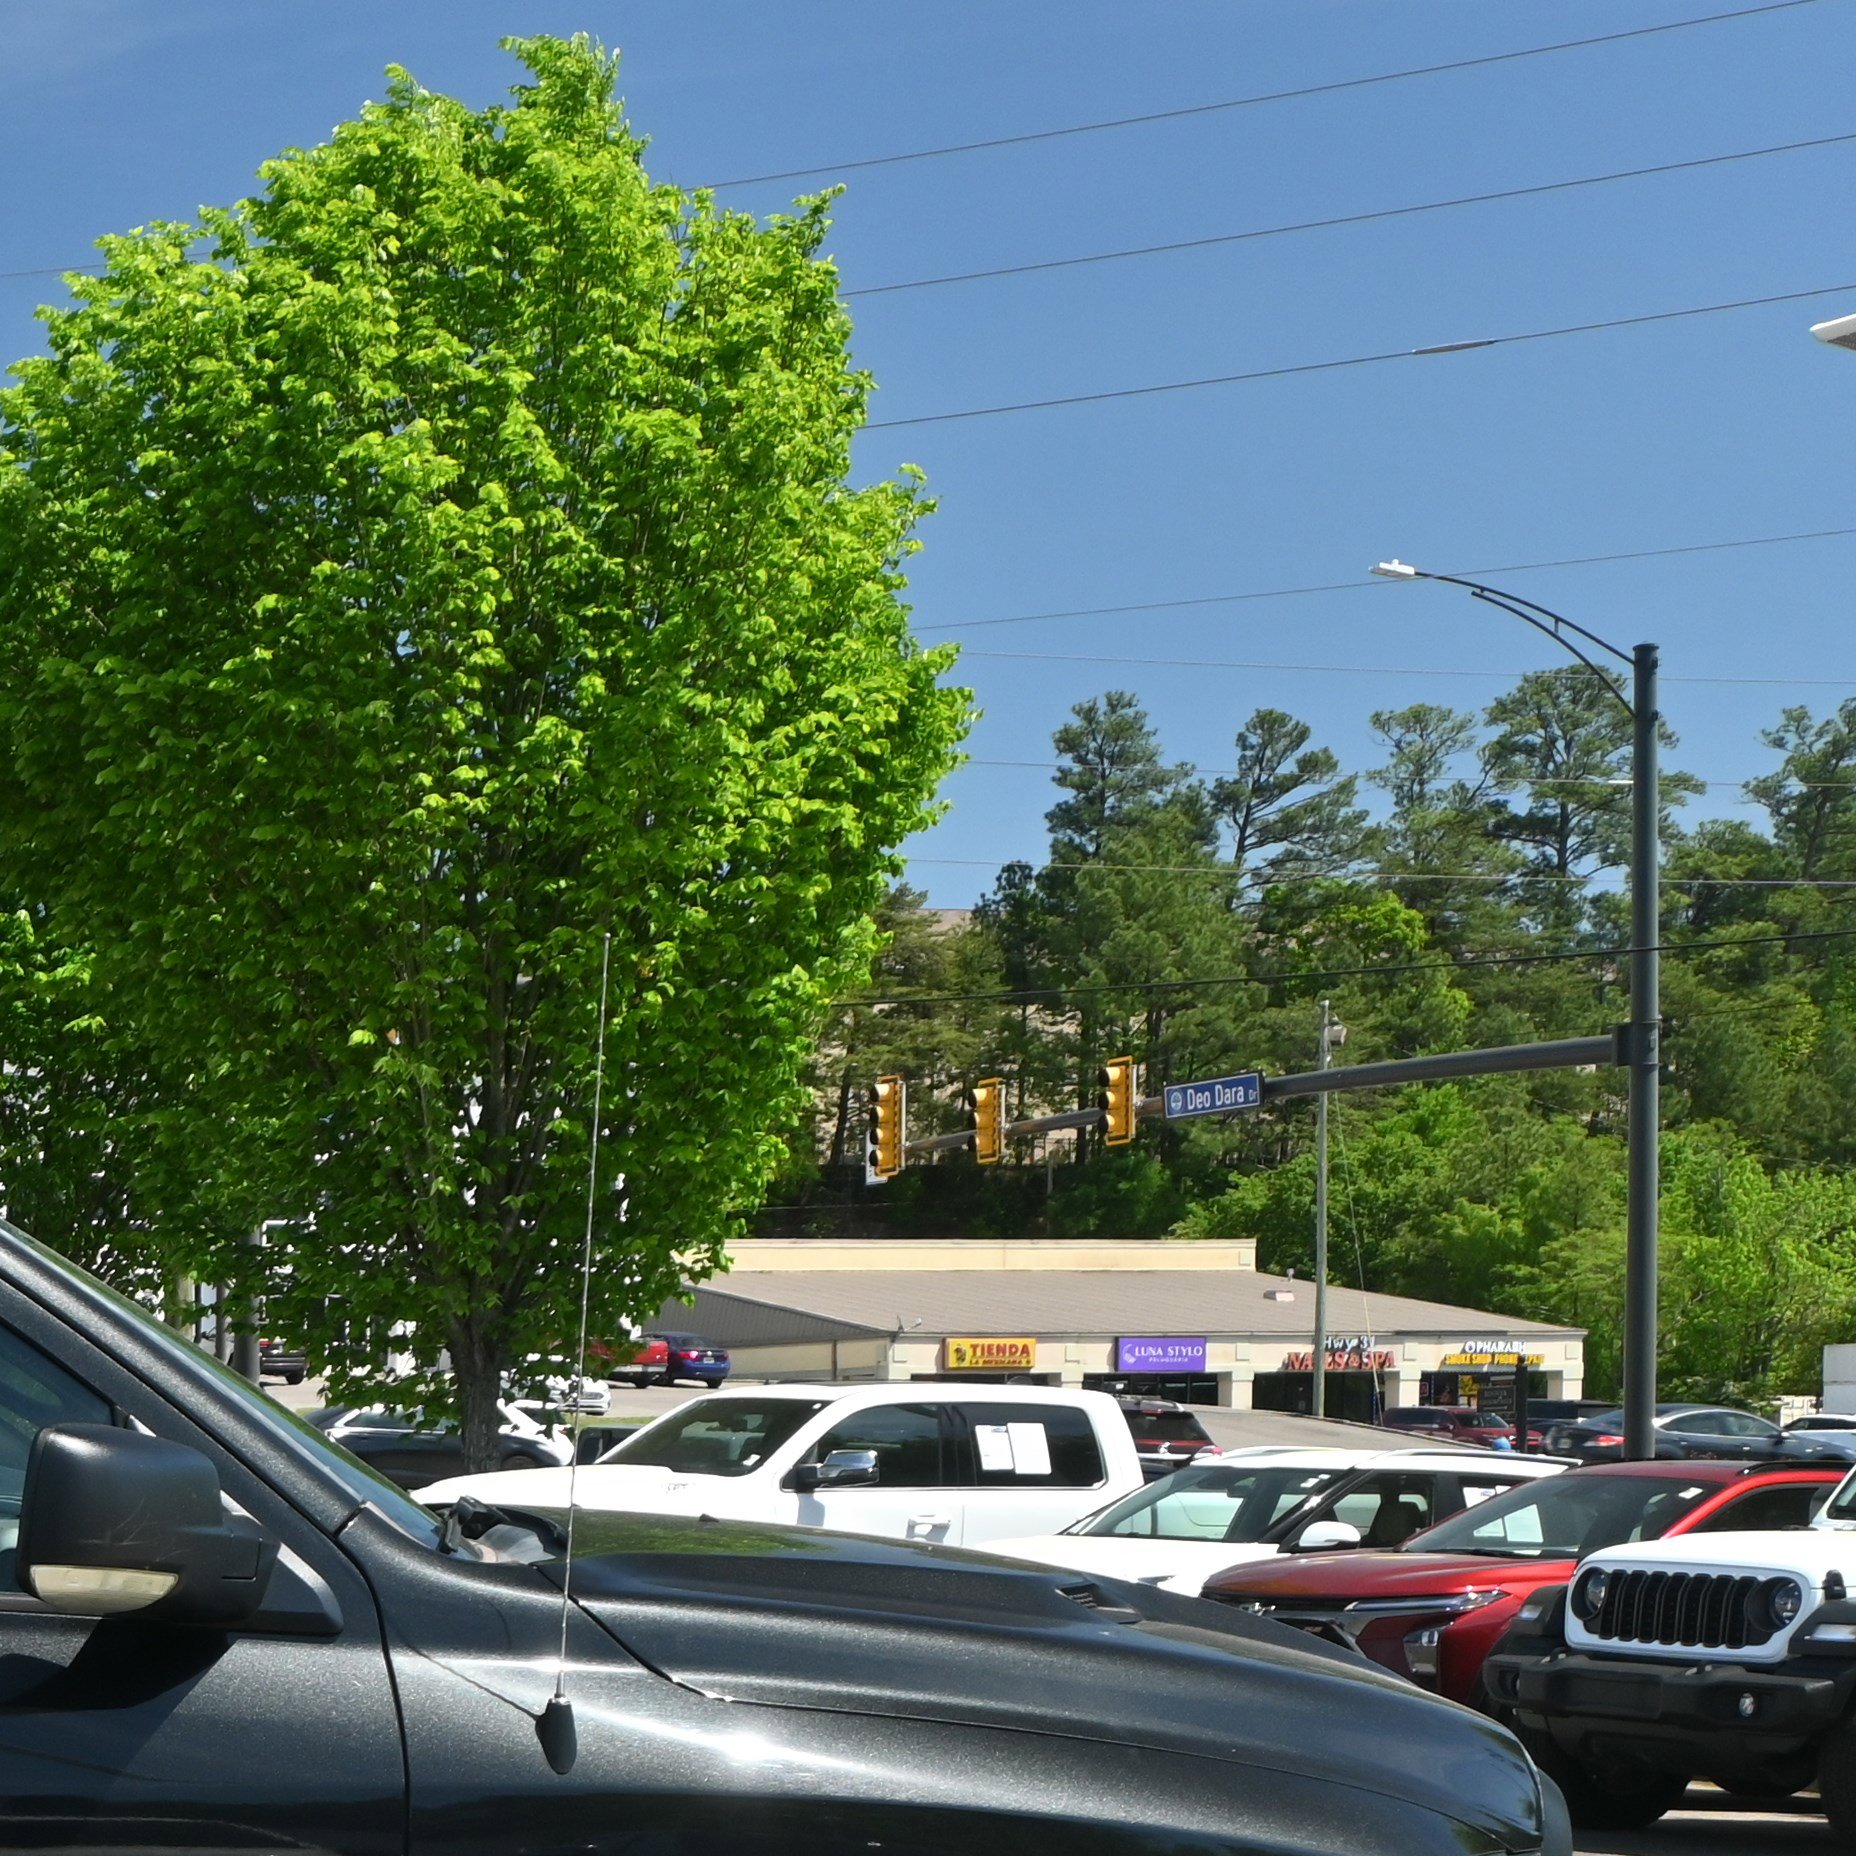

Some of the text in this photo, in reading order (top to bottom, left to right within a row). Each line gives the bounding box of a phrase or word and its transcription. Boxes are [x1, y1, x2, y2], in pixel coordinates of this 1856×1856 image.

[1187, 1088, 1211, 1110] Deo
[1215, 1084, 1245, 1106] Dara
[970, 1343, 1031, 1356] TIENDA
[1135, 1345, 1203, 1357] LUNA STYLO
[1287, 1351, 1348, 1370] NALS
